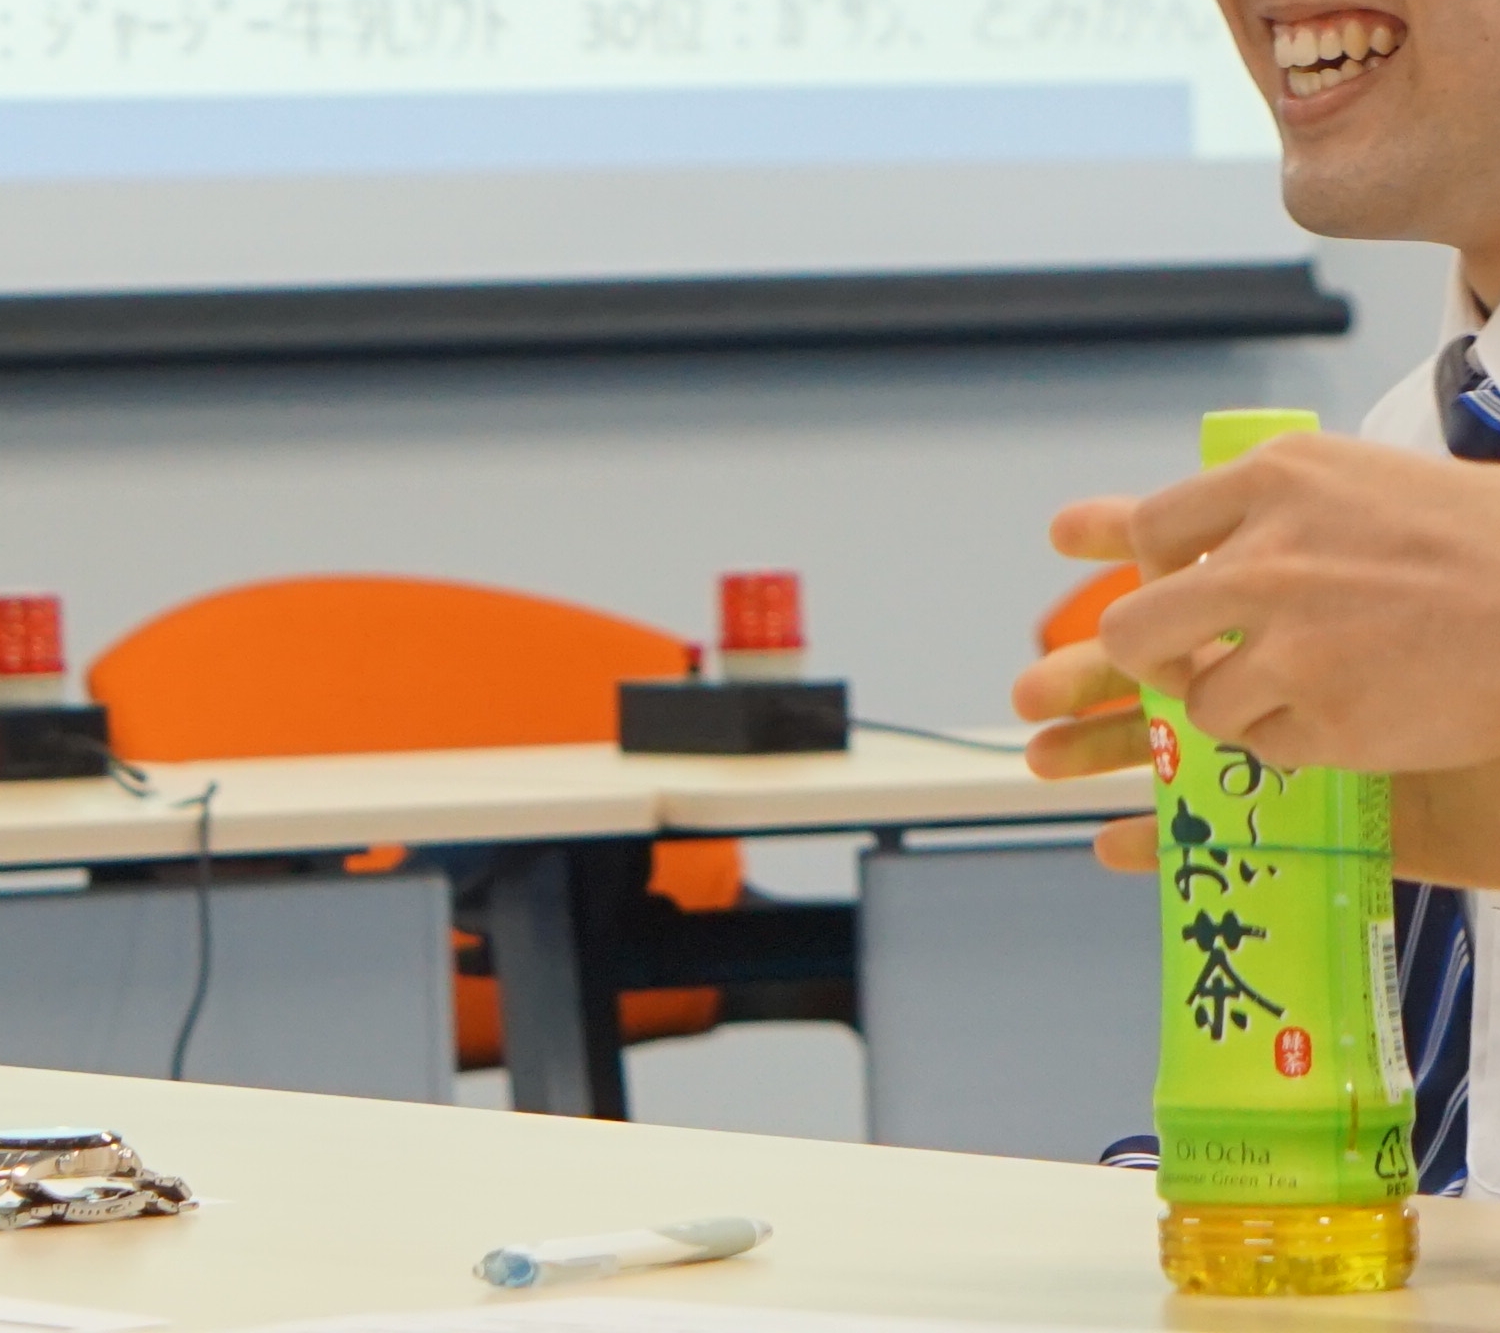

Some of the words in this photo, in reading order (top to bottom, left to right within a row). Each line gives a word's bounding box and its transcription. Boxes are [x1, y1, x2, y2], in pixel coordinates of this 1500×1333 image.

[1170, 795, 1286, 1041] お茶
[1176, 1138, 1197, 1161] Oi
[1205, 1137, 1271, 1166] Ocha
[1211, 1169, 1260, 1188] Green
[1267, 1171, 1298, 1189] Tea
